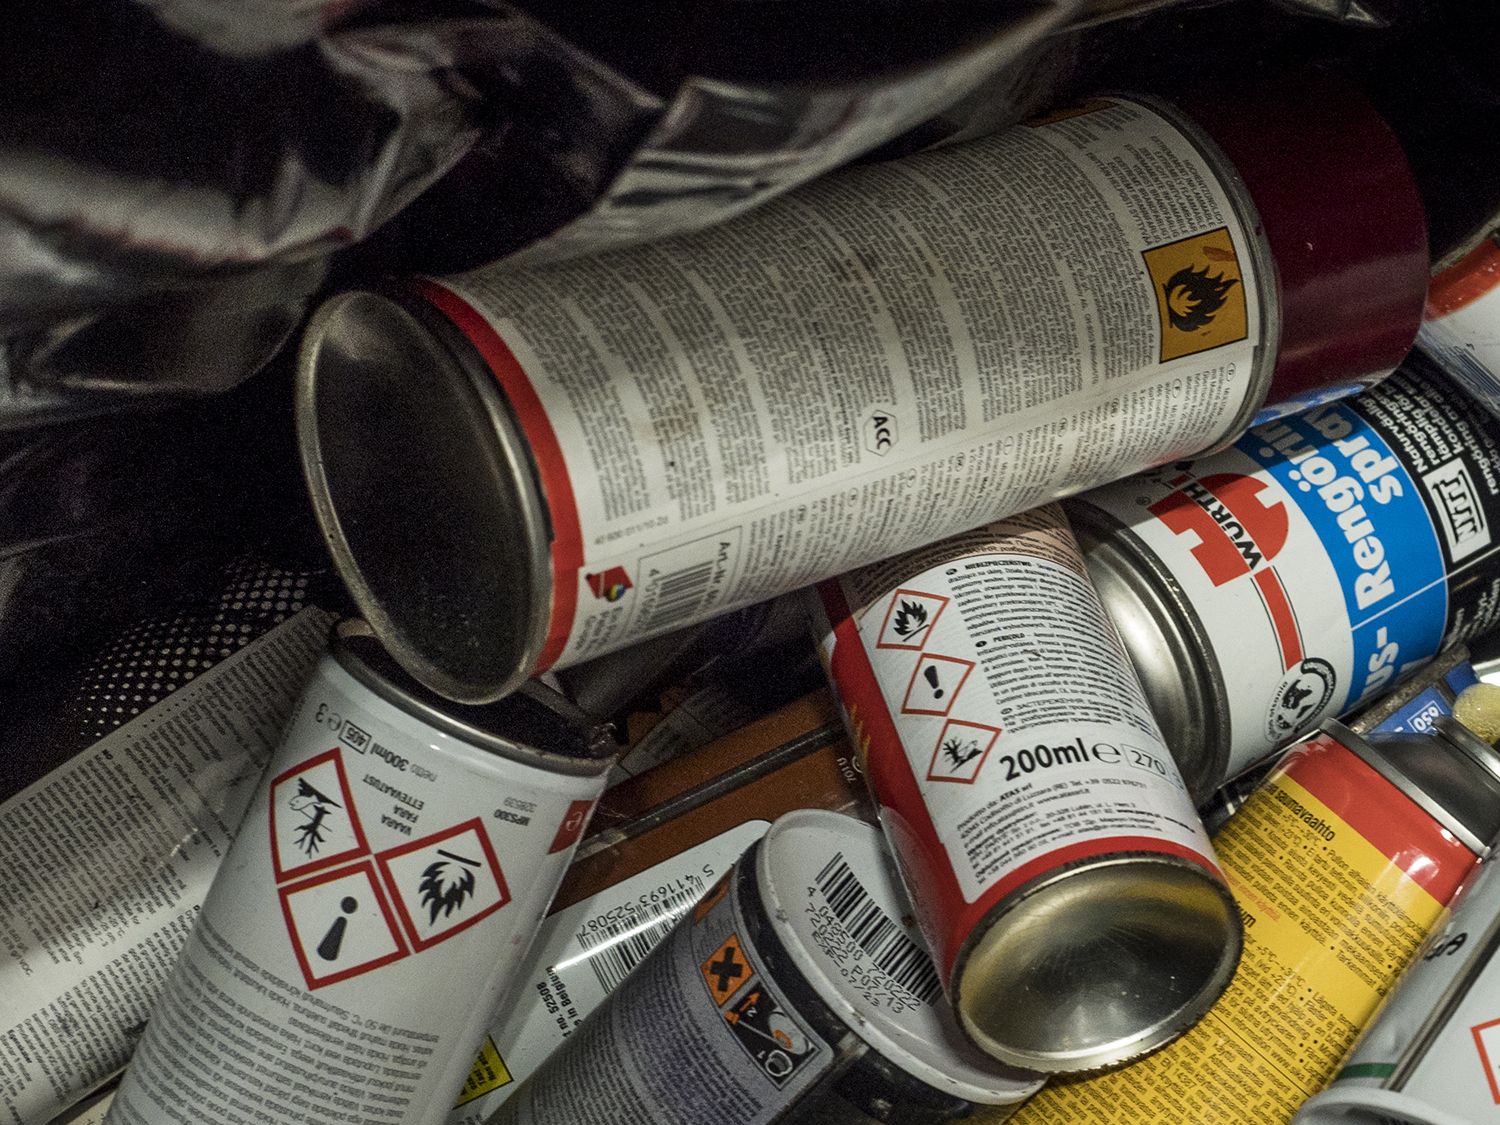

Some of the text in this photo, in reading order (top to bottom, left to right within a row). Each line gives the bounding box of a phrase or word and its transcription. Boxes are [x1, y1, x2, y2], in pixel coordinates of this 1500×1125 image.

[1184, 479, 1262, 567] WÜRTH
[1438, 475, 1478, 542] NYTT
[369, 741, 410, 771] 300ml
[999, 737, 1090, 781] 200ml
[361, 773, 424, 809] ETTEVAATUST
[379, 813, 413, 835] VAARA
[392, 804, 419, 822] FARA
[577, 900, 635, 937] 525087
[804, 884, 921, 1012] 4 048500 720222
[534, 980, 559, 1016] 52508
